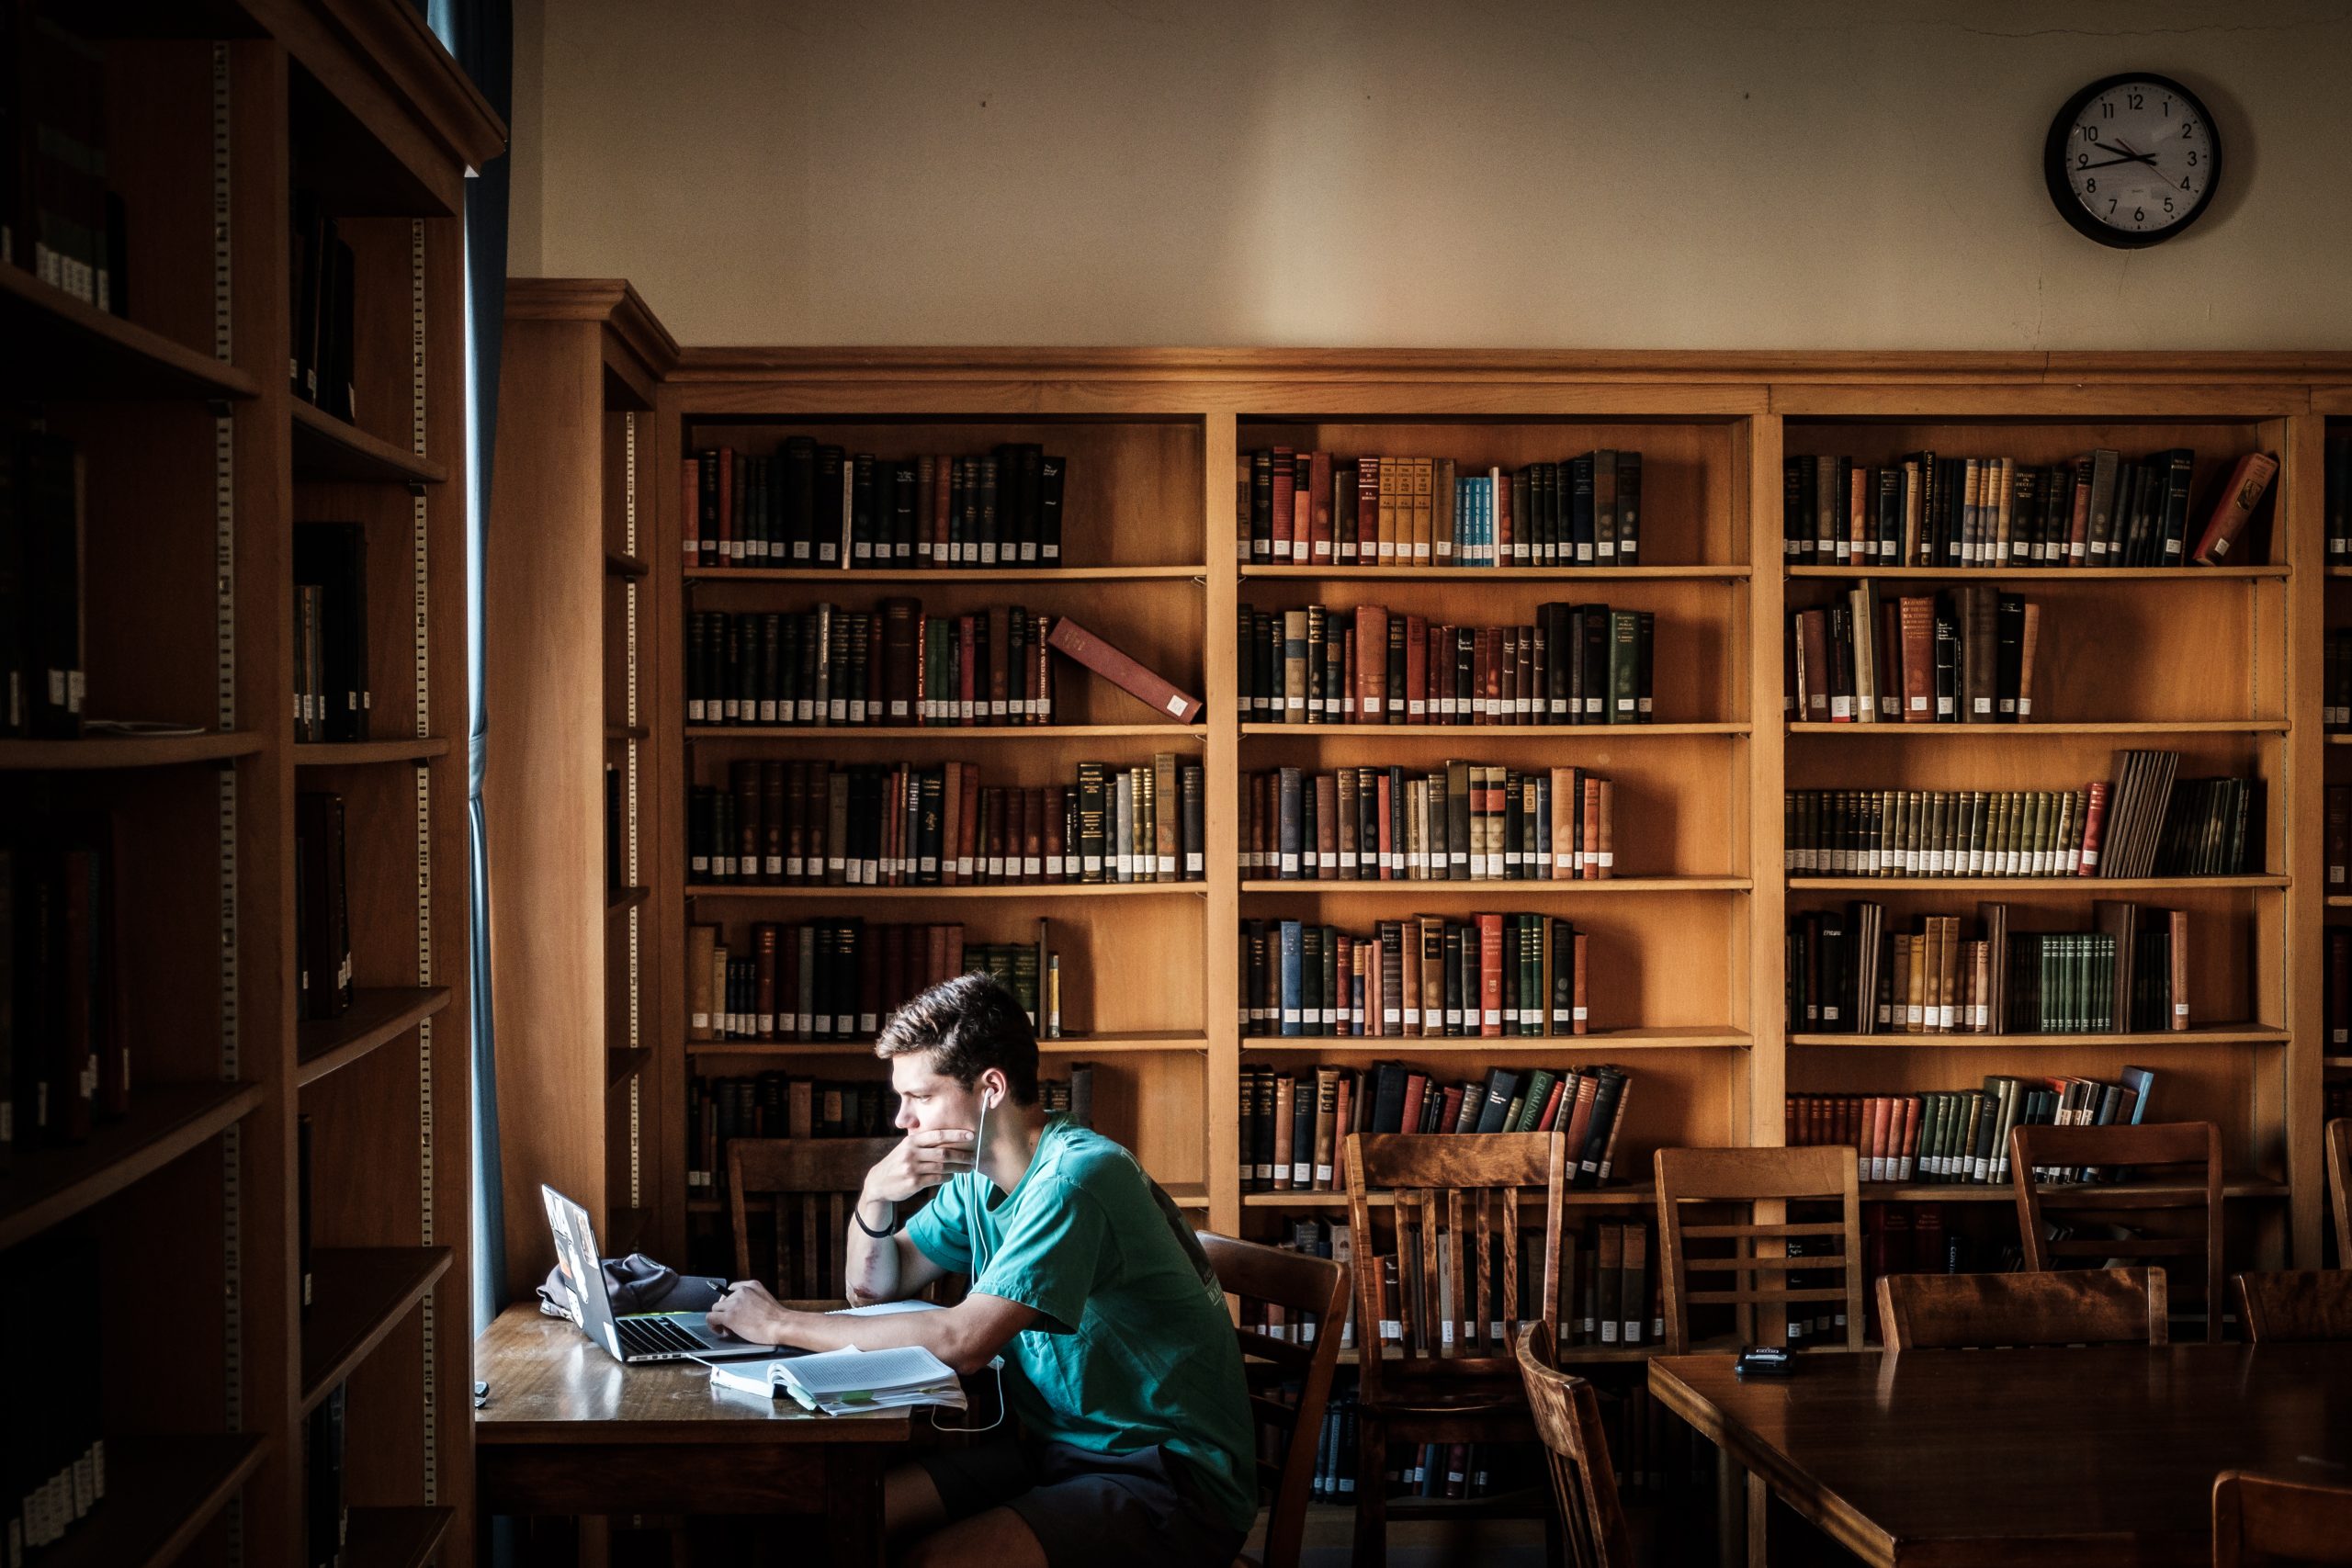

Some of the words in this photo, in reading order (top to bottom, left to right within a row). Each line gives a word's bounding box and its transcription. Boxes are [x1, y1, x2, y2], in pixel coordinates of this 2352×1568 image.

[2127, 95, 2143, 110] 12
[2163, 102, 2168, 118] 1
[2101, 103, 2114, 118] 11
[2082, 126, 2098, 142] 10
[2182, 124, 2192, 139] 2
[2078, 153, 2088, 169] 9
[2188, 152, 2198, 166] 3
[2086, 178, 2097, 193] 8
[2180, 176, 2190, 191] 4
[2109, 199, 2118, 214] 7
[2164, 197, 2174, 213] 5
[2134, 207, 2144, 221] 6
